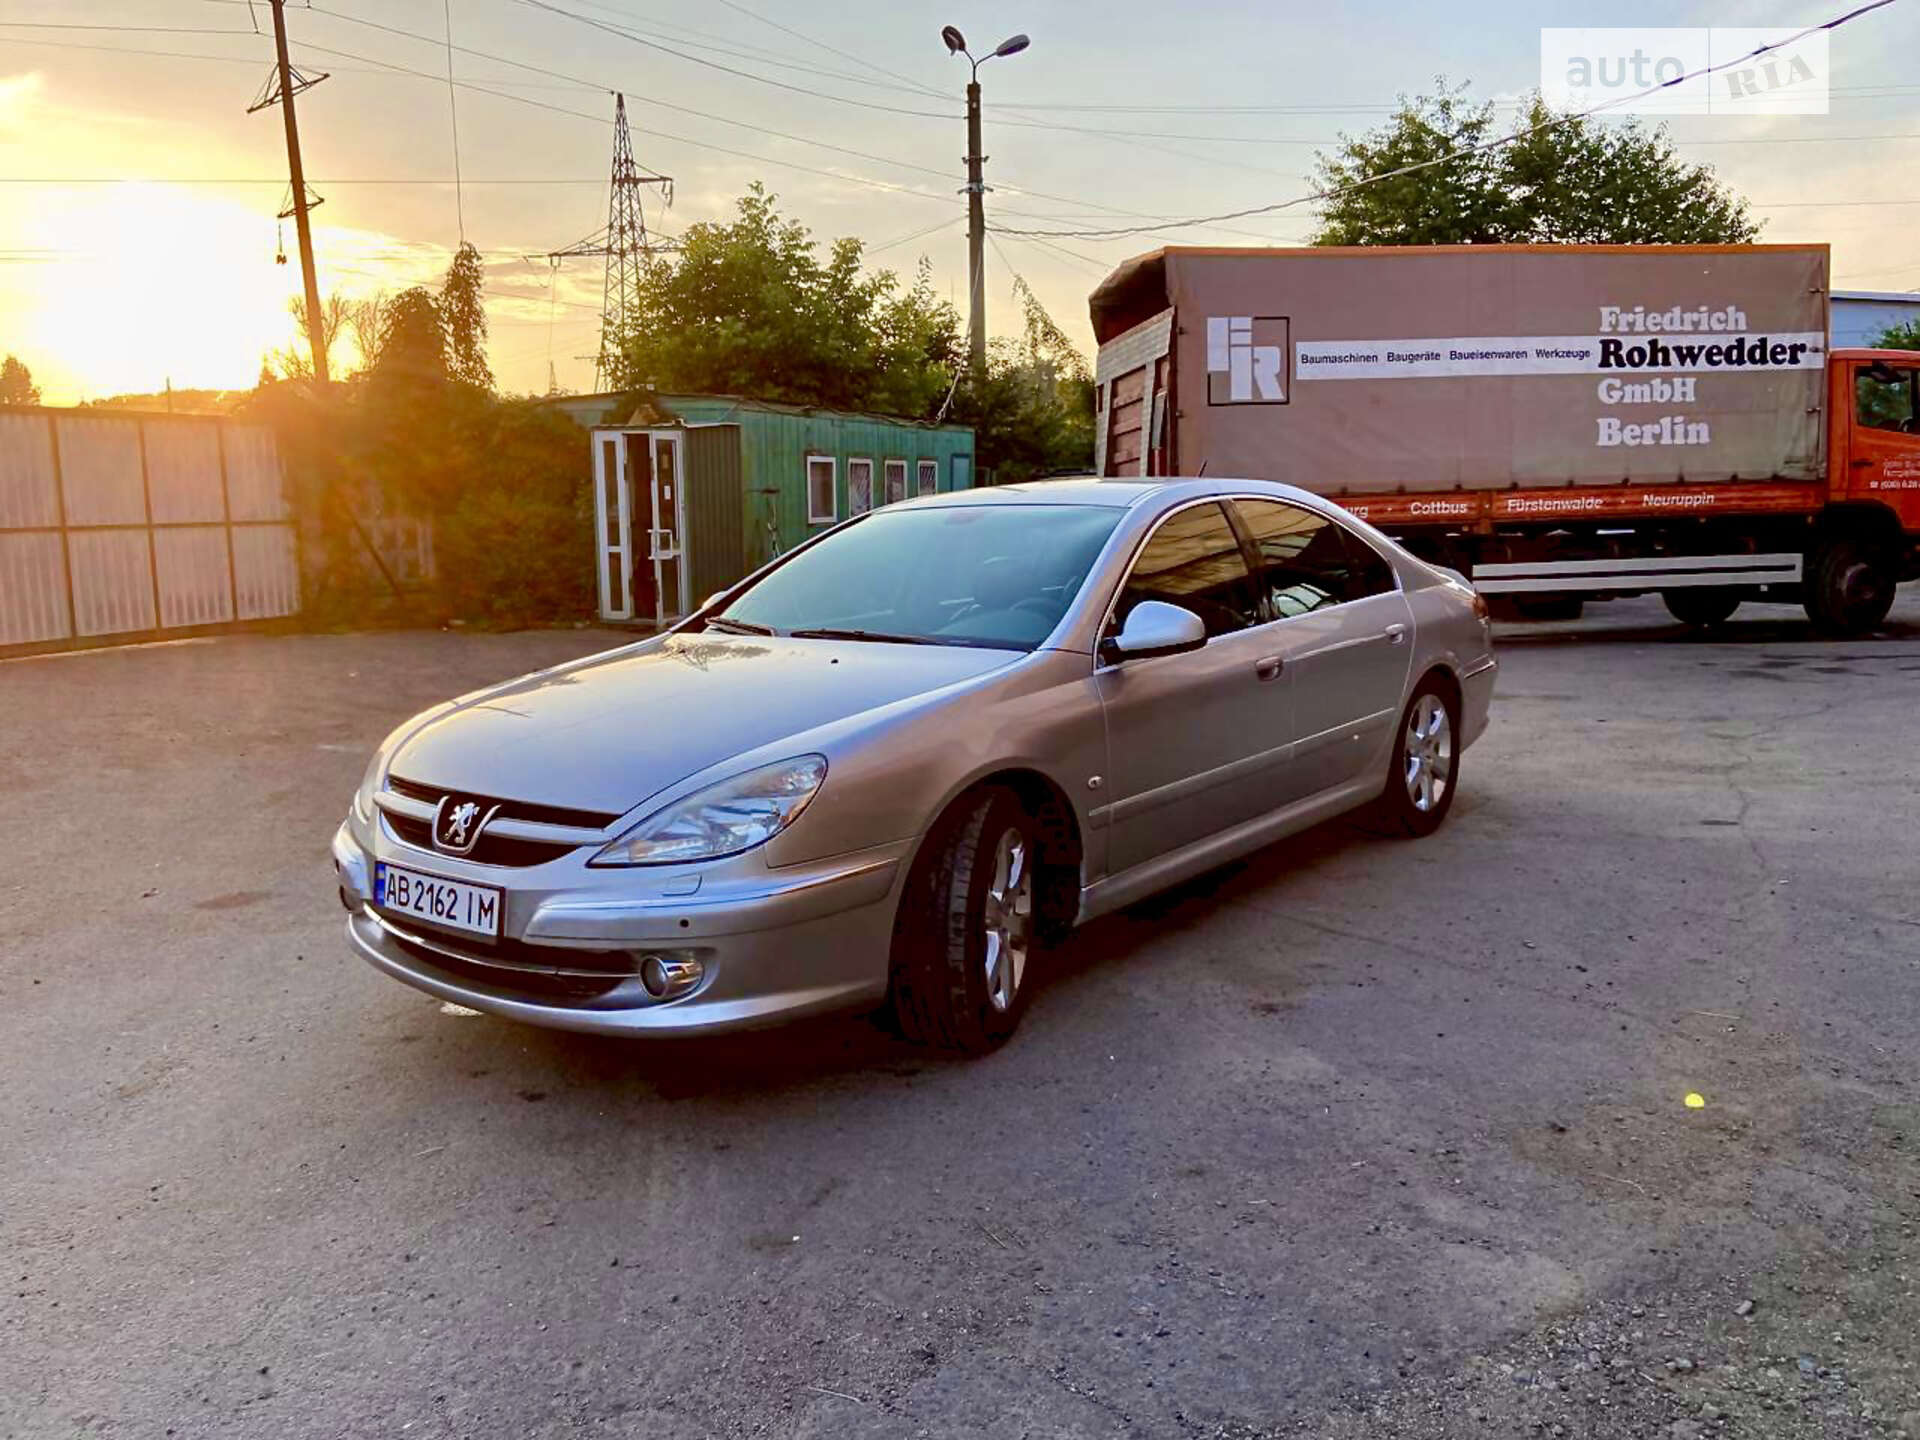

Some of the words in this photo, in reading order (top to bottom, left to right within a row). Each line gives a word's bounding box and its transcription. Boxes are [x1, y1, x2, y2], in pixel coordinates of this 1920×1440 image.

[1599, 306, 1748, 333] Friedrich
[1301, 353, 1379, 365] Baumaschinen
[1387, 351, 1441, 364] Baugeräte
[1450, 349, 1529, 361] Baueisenwaren
[1536, 348, 1591, 360] Werkzeuge
[1598, 336, 1807, 369] Rohwedder
[1597, 377, 1697, 405] GmbH
[1596, 416, 1711, 447] Berlin
[1410, 501, 1468, 515] Cottbus
[1507, 496, 1604, 512] Fürstenwalde
[1641, 491, 1715, 507] Neuruppin
[386, 872, 411, 907] AB
[414, 879, 458, 921] 2162
[467, 891, 495, 930] IM
